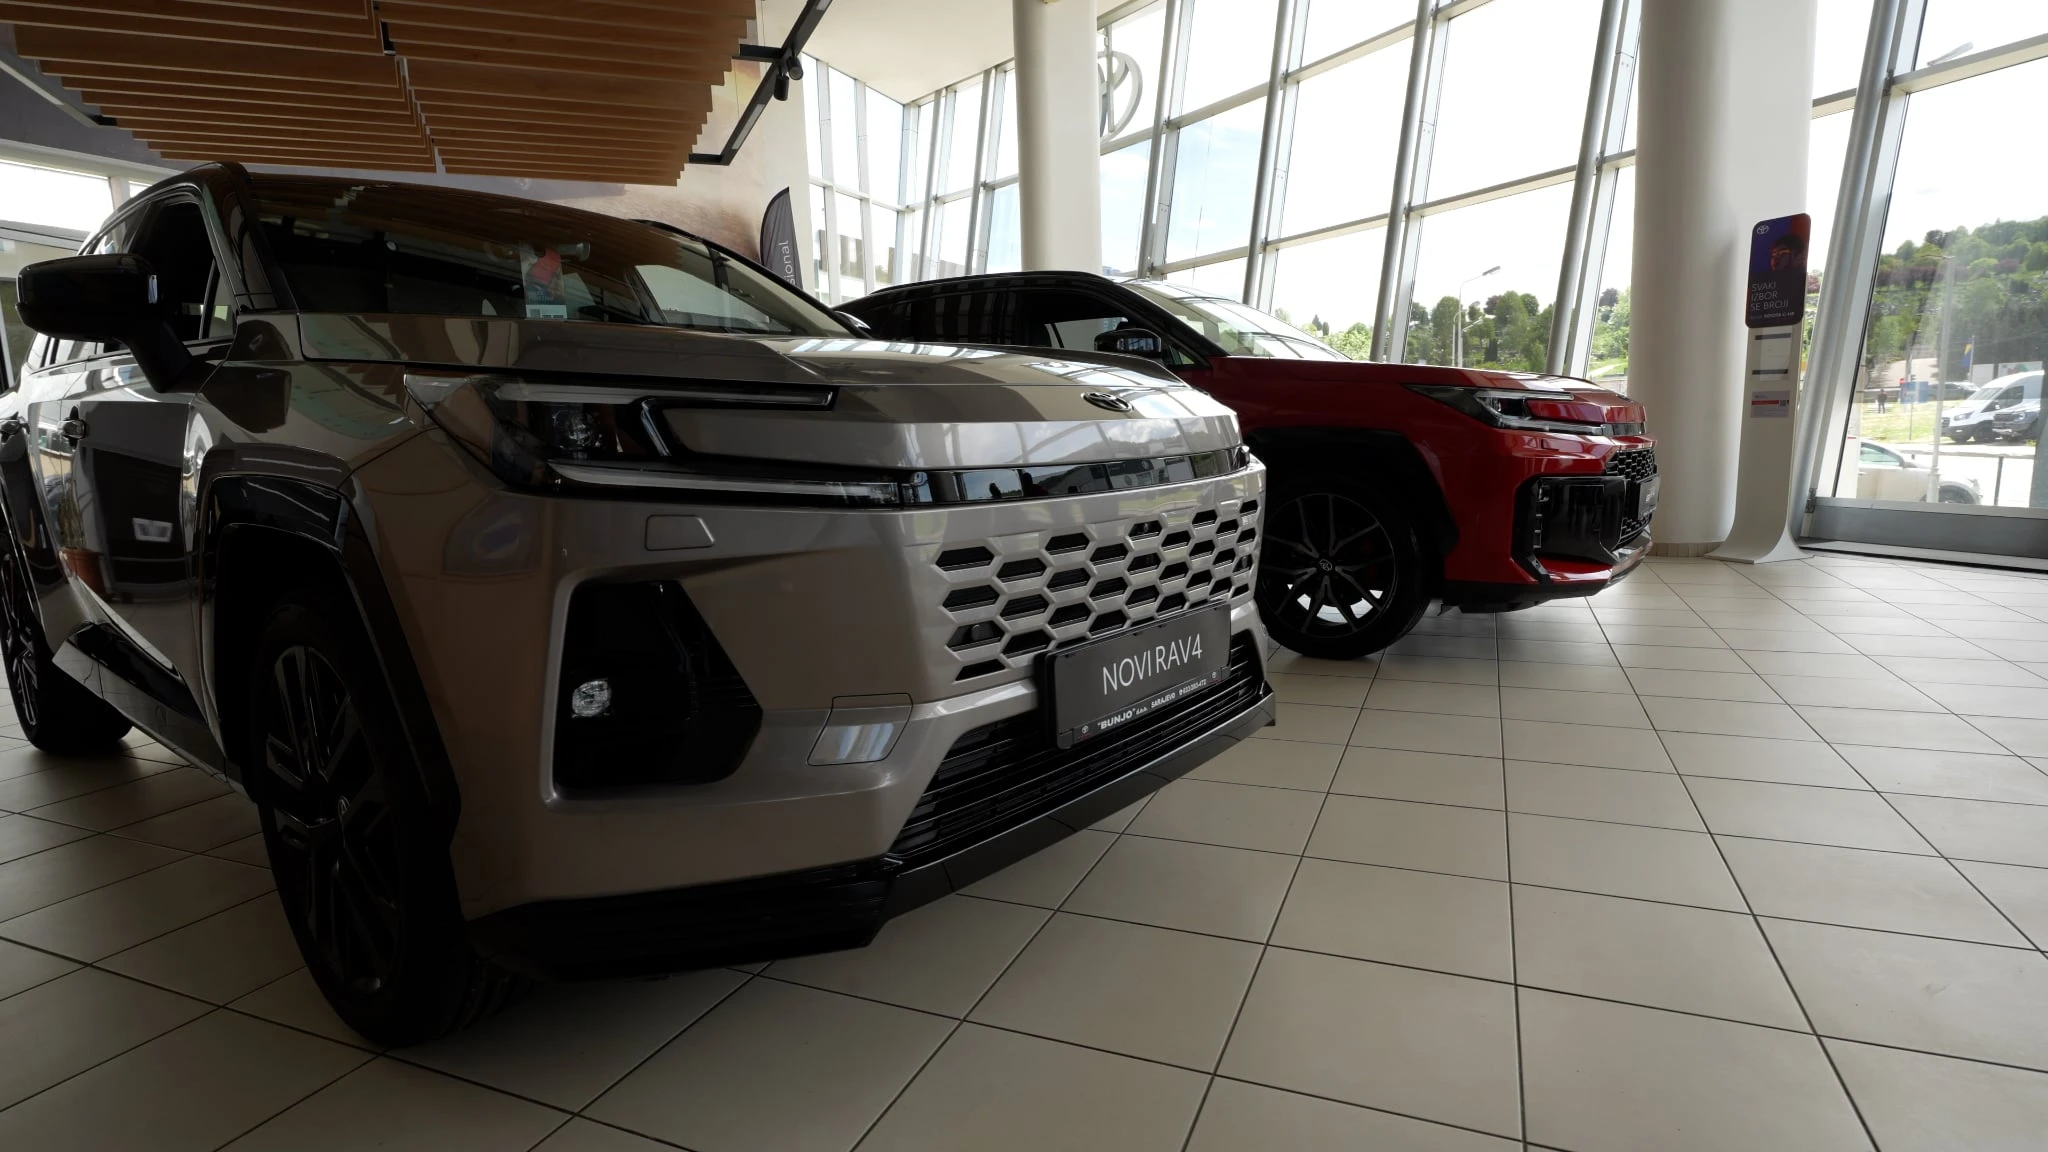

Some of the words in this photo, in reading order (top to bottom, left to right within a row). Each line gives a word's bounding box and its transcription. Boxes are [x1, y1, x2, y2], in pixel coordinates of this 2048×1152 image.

[1751, 281, 1776, 292] SVAKI
[1751, 291, 1778, 302] IZBOR
[1750, 302, 1761, 312] SE
[1763, 299, 1788, 310] BROJI
[1102, 650, 1152, 695] NOVI
[1155, 633, 1203, 674] RAV4
[1151, 692, 1176, 708] SARAJEVO
